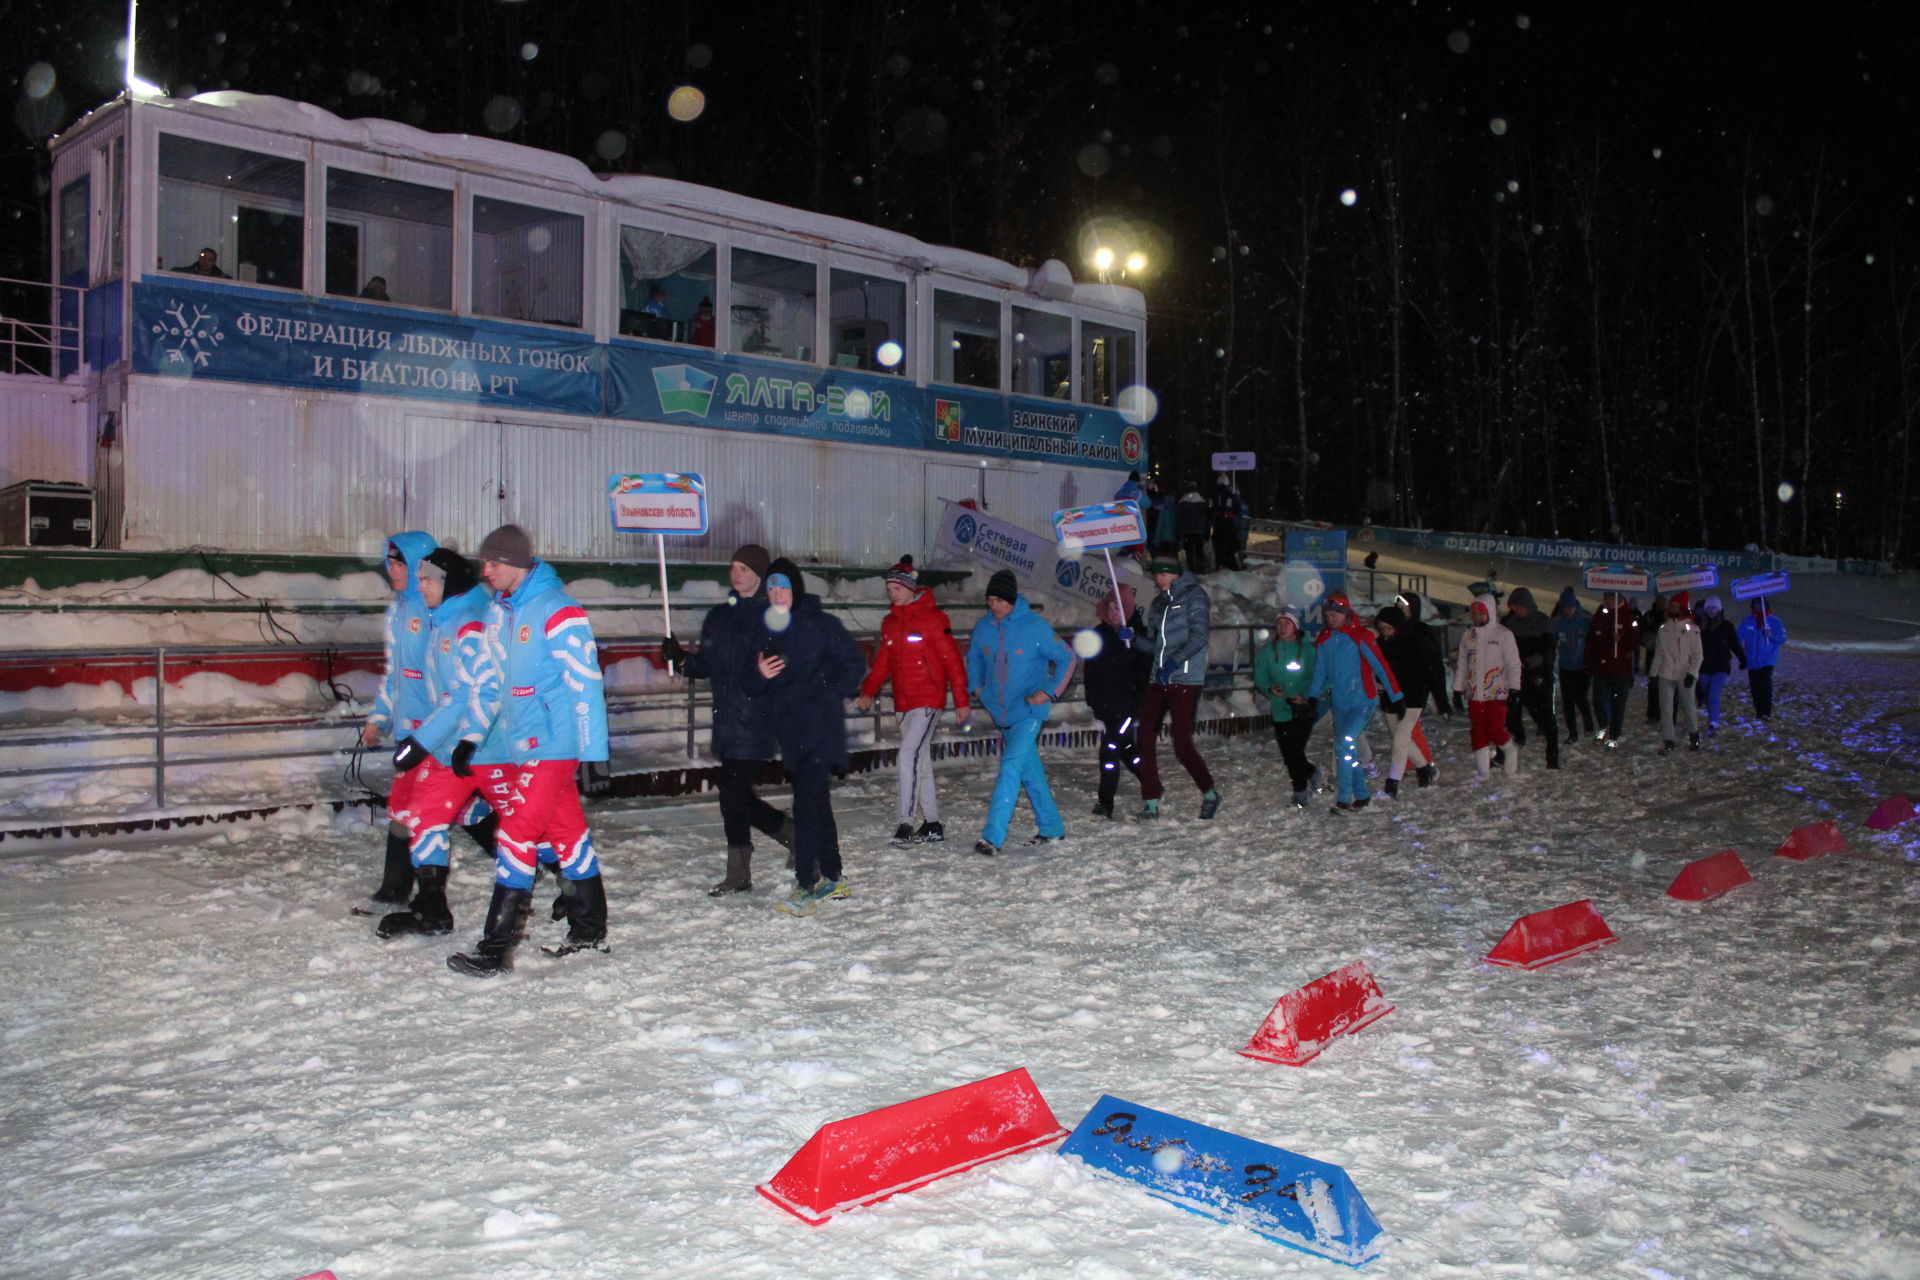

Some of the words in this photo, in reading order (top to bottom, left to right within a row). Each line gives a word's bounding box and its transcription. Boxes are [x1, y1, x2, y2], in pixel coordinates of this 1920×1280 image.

[236, 312, 392, 351] ФЕДЕРАЦИЯ
[398, 333, 513, 365] ЛЫЖНЫХ
[518, 348, 590, 374] ГОНОК
[312, 355, 334, 379] И
[341, 357, 484, 393] БИАТЛОНА
[489, 374, 519, 396] РТ
[724, 409, 760, 425] центр
[764, 414, 828, 432] спортивной
[832, 419, 891, 438] подготовки
[1013, 409, 1077, 435] ЗАИНСКИЙ
[964, 427, 1079, 455] МУНИЦИПАЛЬНЫЙ
[1081, 441, 1119, 462] РАЙОН
[666, 504, 697, 518] область
[978, 522, 1028, 553] Сетевая
[1444, 536, 1534, 556] ФЕДЕРАЦИЯ
[1537, 543, 1601, 560] ЛЫЖНЫХ
[1605, 548, 1644, 562] ГОНОК
[1648, 550, 1657, 562] И
[1659, 551, 1725, 567] БИАТЛОНА
[1728, 555, 1742, 567] РТ
[974, 538, 1035, 572] Компания
